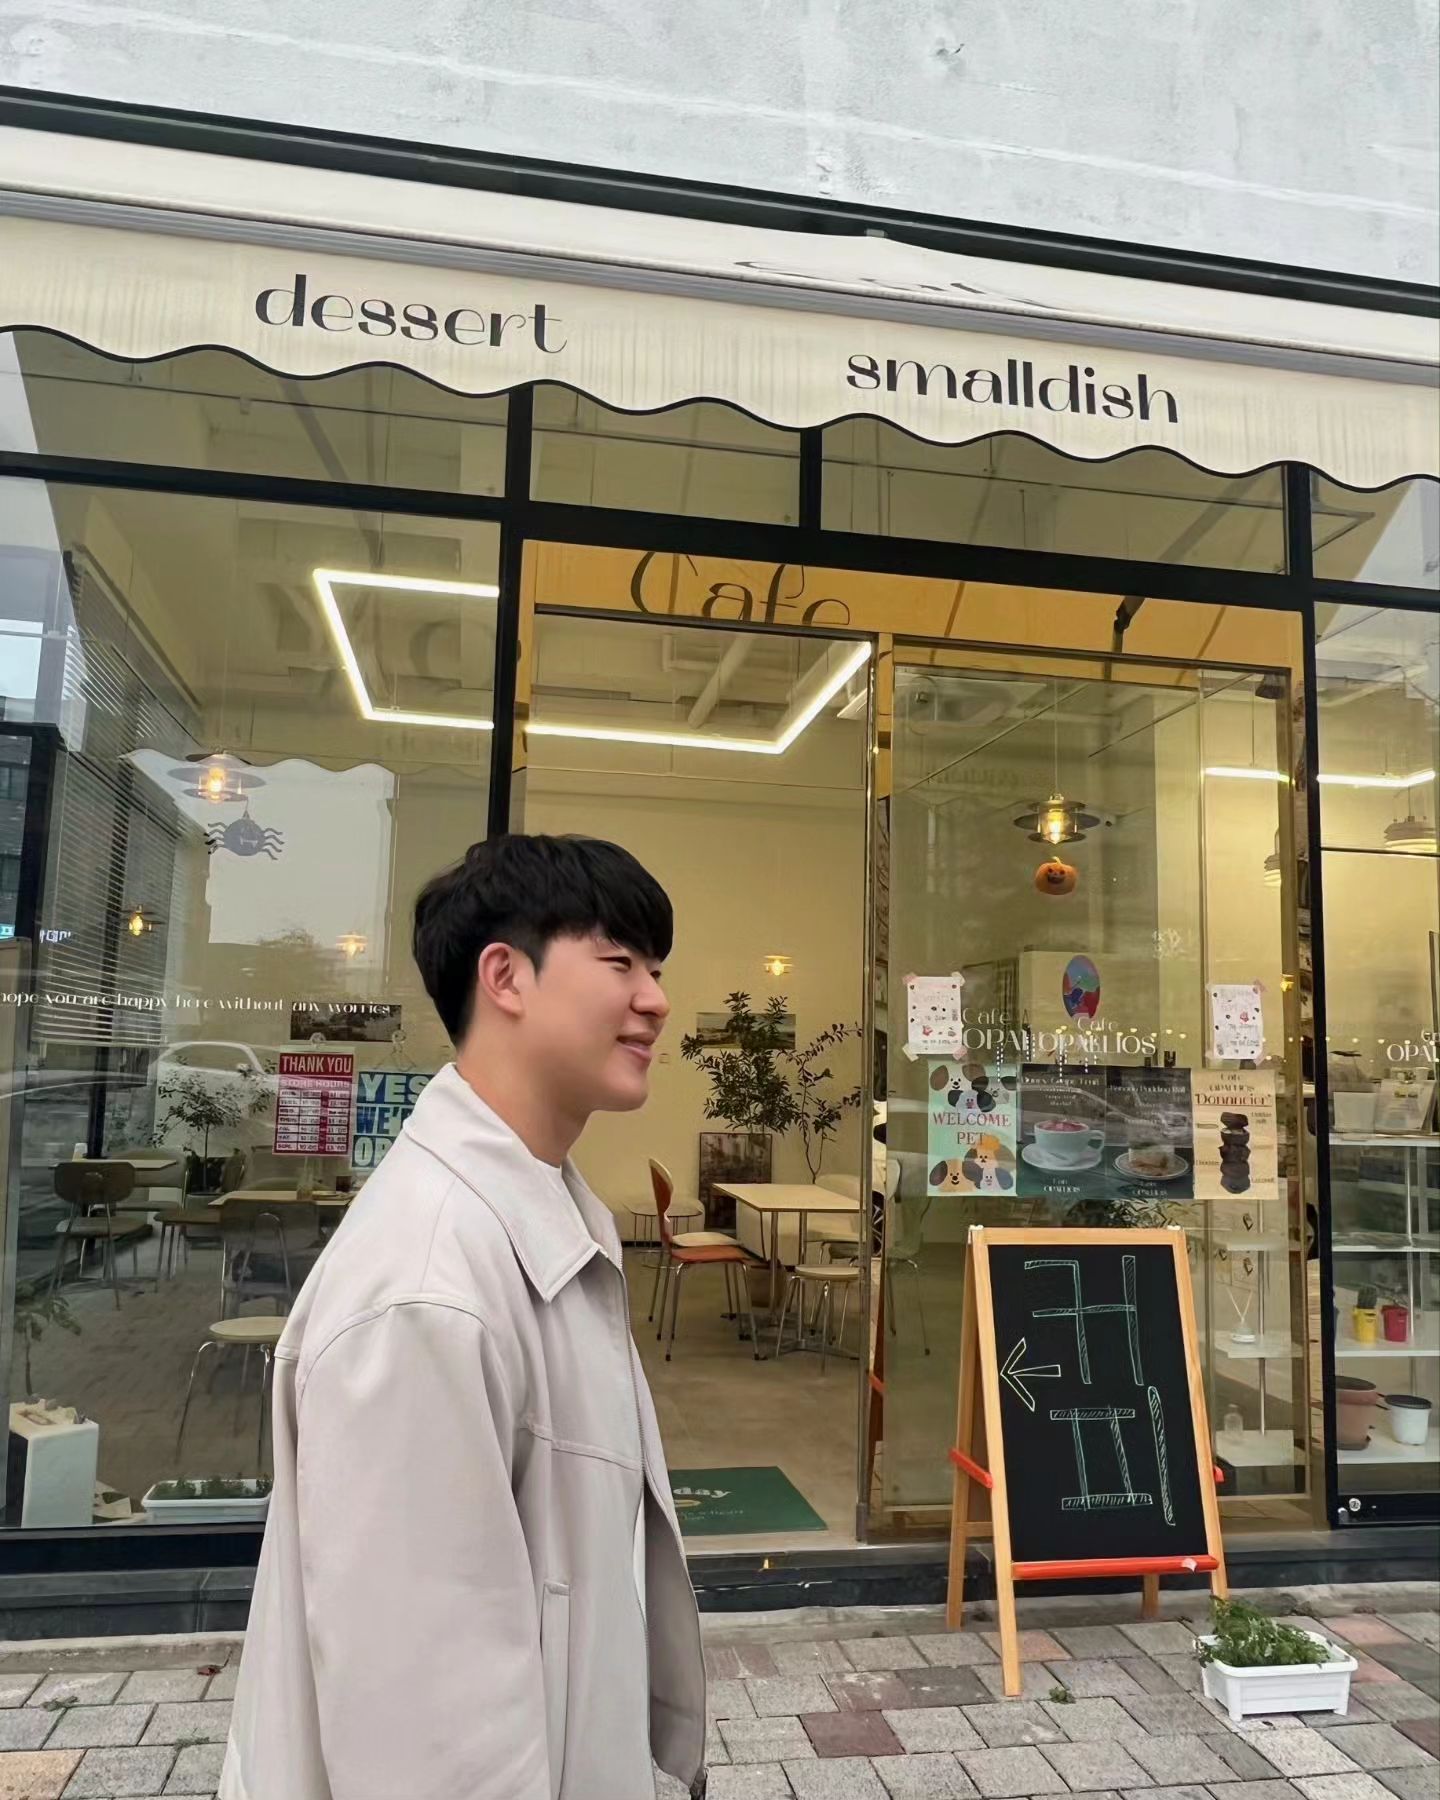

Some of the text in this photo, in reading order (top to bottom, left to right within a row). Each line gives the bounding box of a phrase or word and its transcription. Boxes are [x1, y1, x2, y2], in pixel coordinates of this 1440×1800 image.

[255, 273, 567, 354] dessert
[846, 354, 1178, 423] smalldish
[83, 994, 112, 1006] are
[117, 992, 168, 1011] happy
[176, 994, 214, 1009] here
[218, 996, 284, 1011] without
[292, 1001, 320, 1013] any
[328, 1001, 391, 1014] worries
[962, 1007, 1012, 1026] Cafe
[1077, 1016, 1118, 1032] Cafe
[281, 1055, 352, 1074] THANK YOU
[360, 1073, 430, 1104] YES
[932, 1111, 1012, 1127] WELCOME
[956, 1131, 986, 1145] PET
